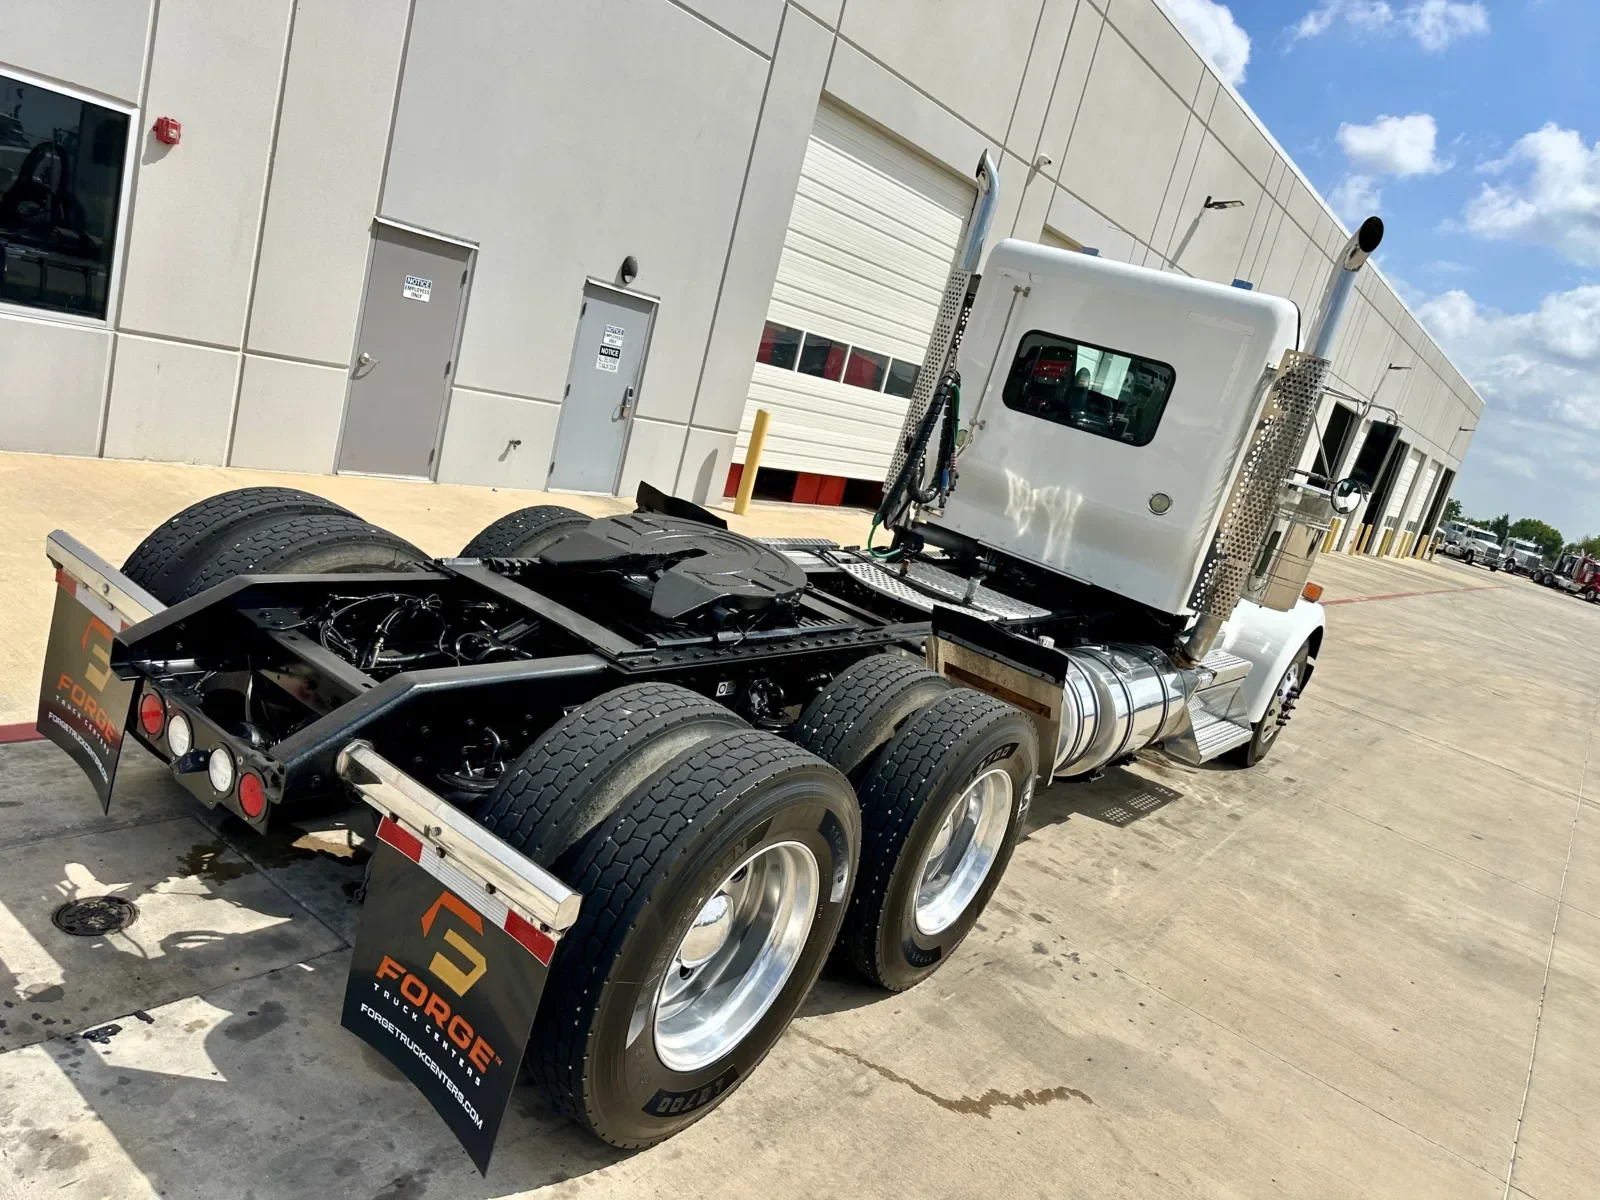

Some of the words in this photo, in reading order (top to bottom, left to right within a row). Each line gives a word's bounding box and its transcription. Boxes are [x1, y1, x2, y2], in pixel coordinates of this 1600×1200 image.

[404, 284, 430, 295] EMPLOYEES
[406, 277, 430, 289] NOTICE
[600, 347, 619, 357] NOTICE
[55, 694, 81, 719] TRUCK
[84, 719, 110, 755] CENTERS
[57, 673, 116, 743] FORGE
[373, 982, 418, 1021] TRUCK
[425, 1024, 481, 1086] CENTERS
[376, 954, 495, 1074] FORGE
[360, 1002, 484, 1130] FORGETRUCKCENTERS.COM
